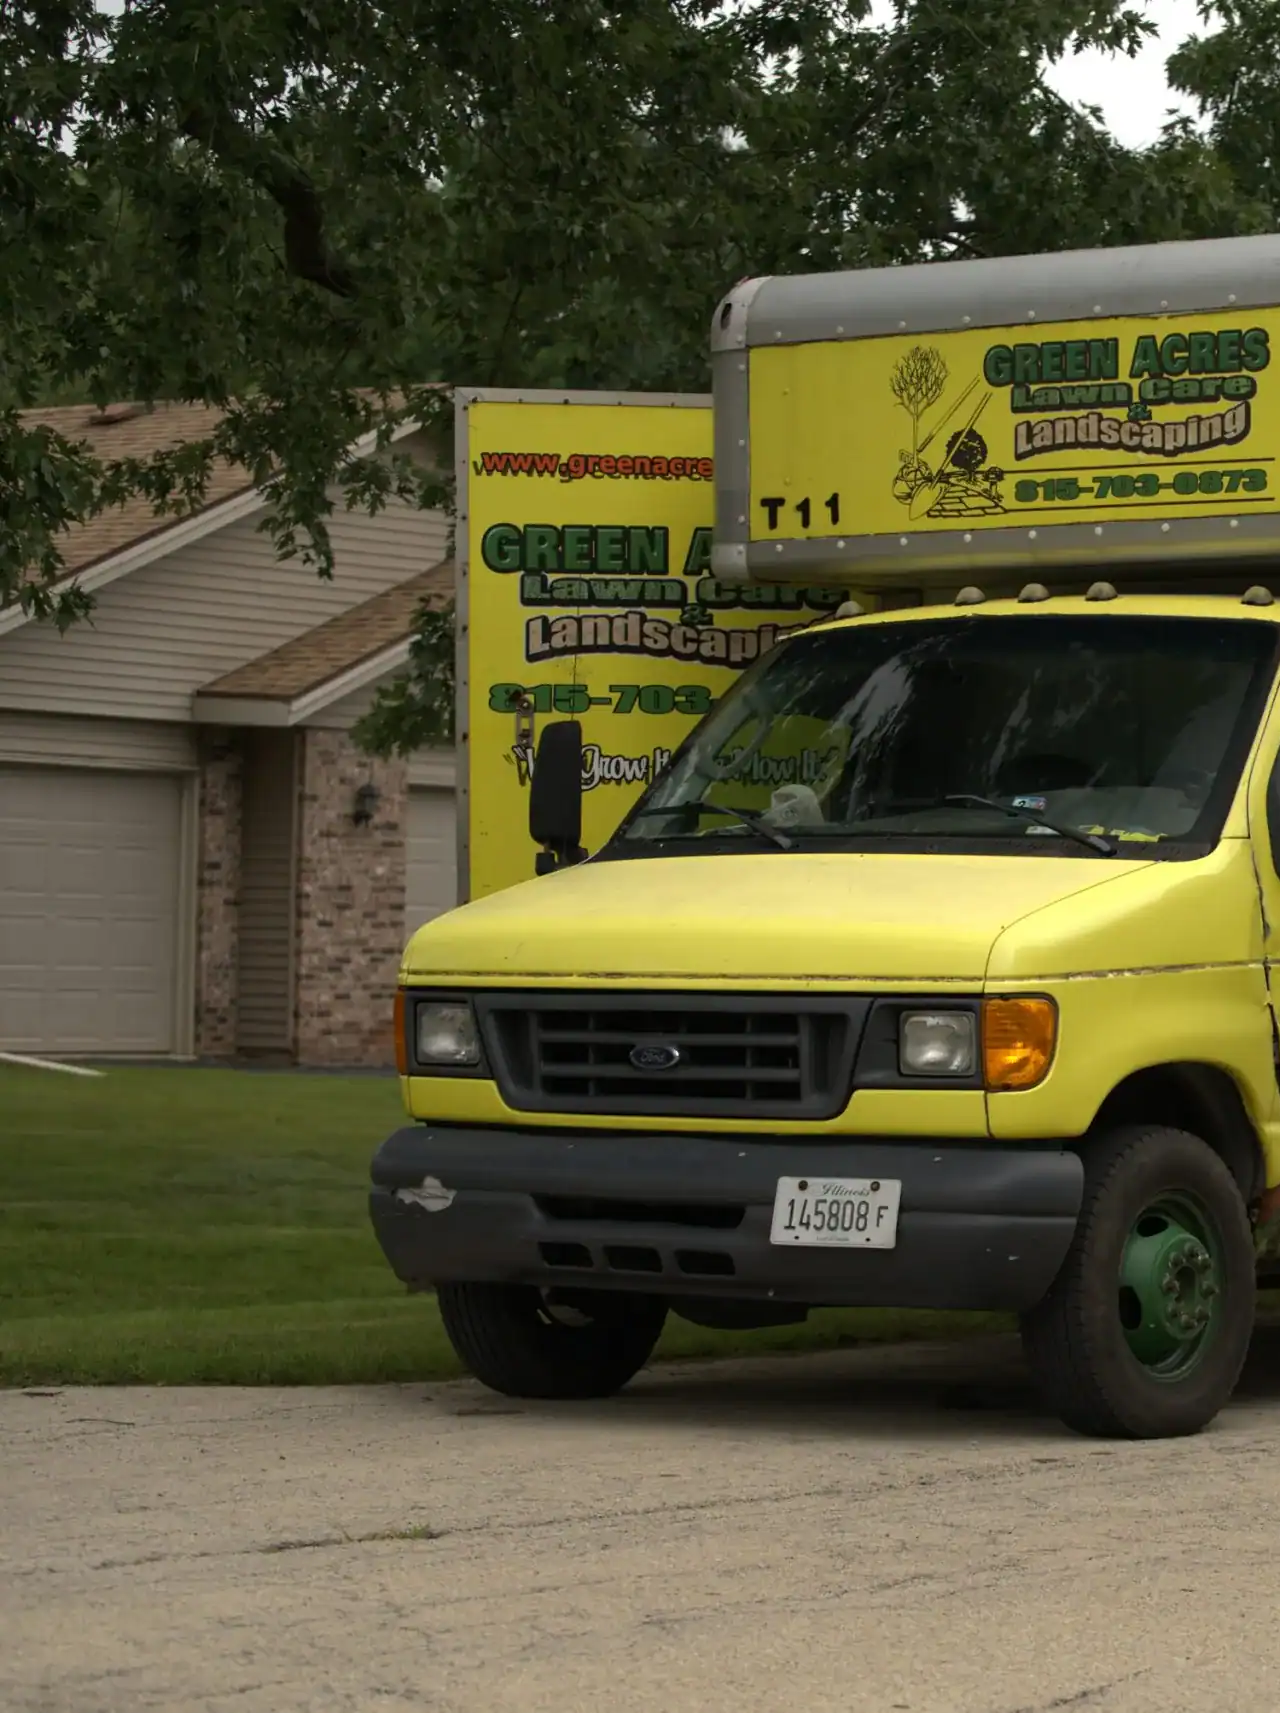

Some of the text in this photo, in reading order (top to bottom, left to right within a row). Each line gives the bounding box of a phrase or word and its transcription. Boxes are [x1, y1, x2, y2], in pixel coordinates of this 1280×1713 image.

[983, 328, 1270, 388] GREEN ACRES
[1011, 375, 1257, 413] Lawn Care
[1127, 402, 1152, 421] &
[1014, 400, 1250, 461] Landscaping
[482, 452, 714, 480] www.greenacre
[1014, 469, 1268, 502] 815-703-0873
[481, 523, 669, 575] GREEN
[520, 573, 688, 608] Lawn
[680, 602, 713, 626] &
[821, 1183, 870, 1197] Illinois
[784, 1199, 889, 1231] 145808 F
